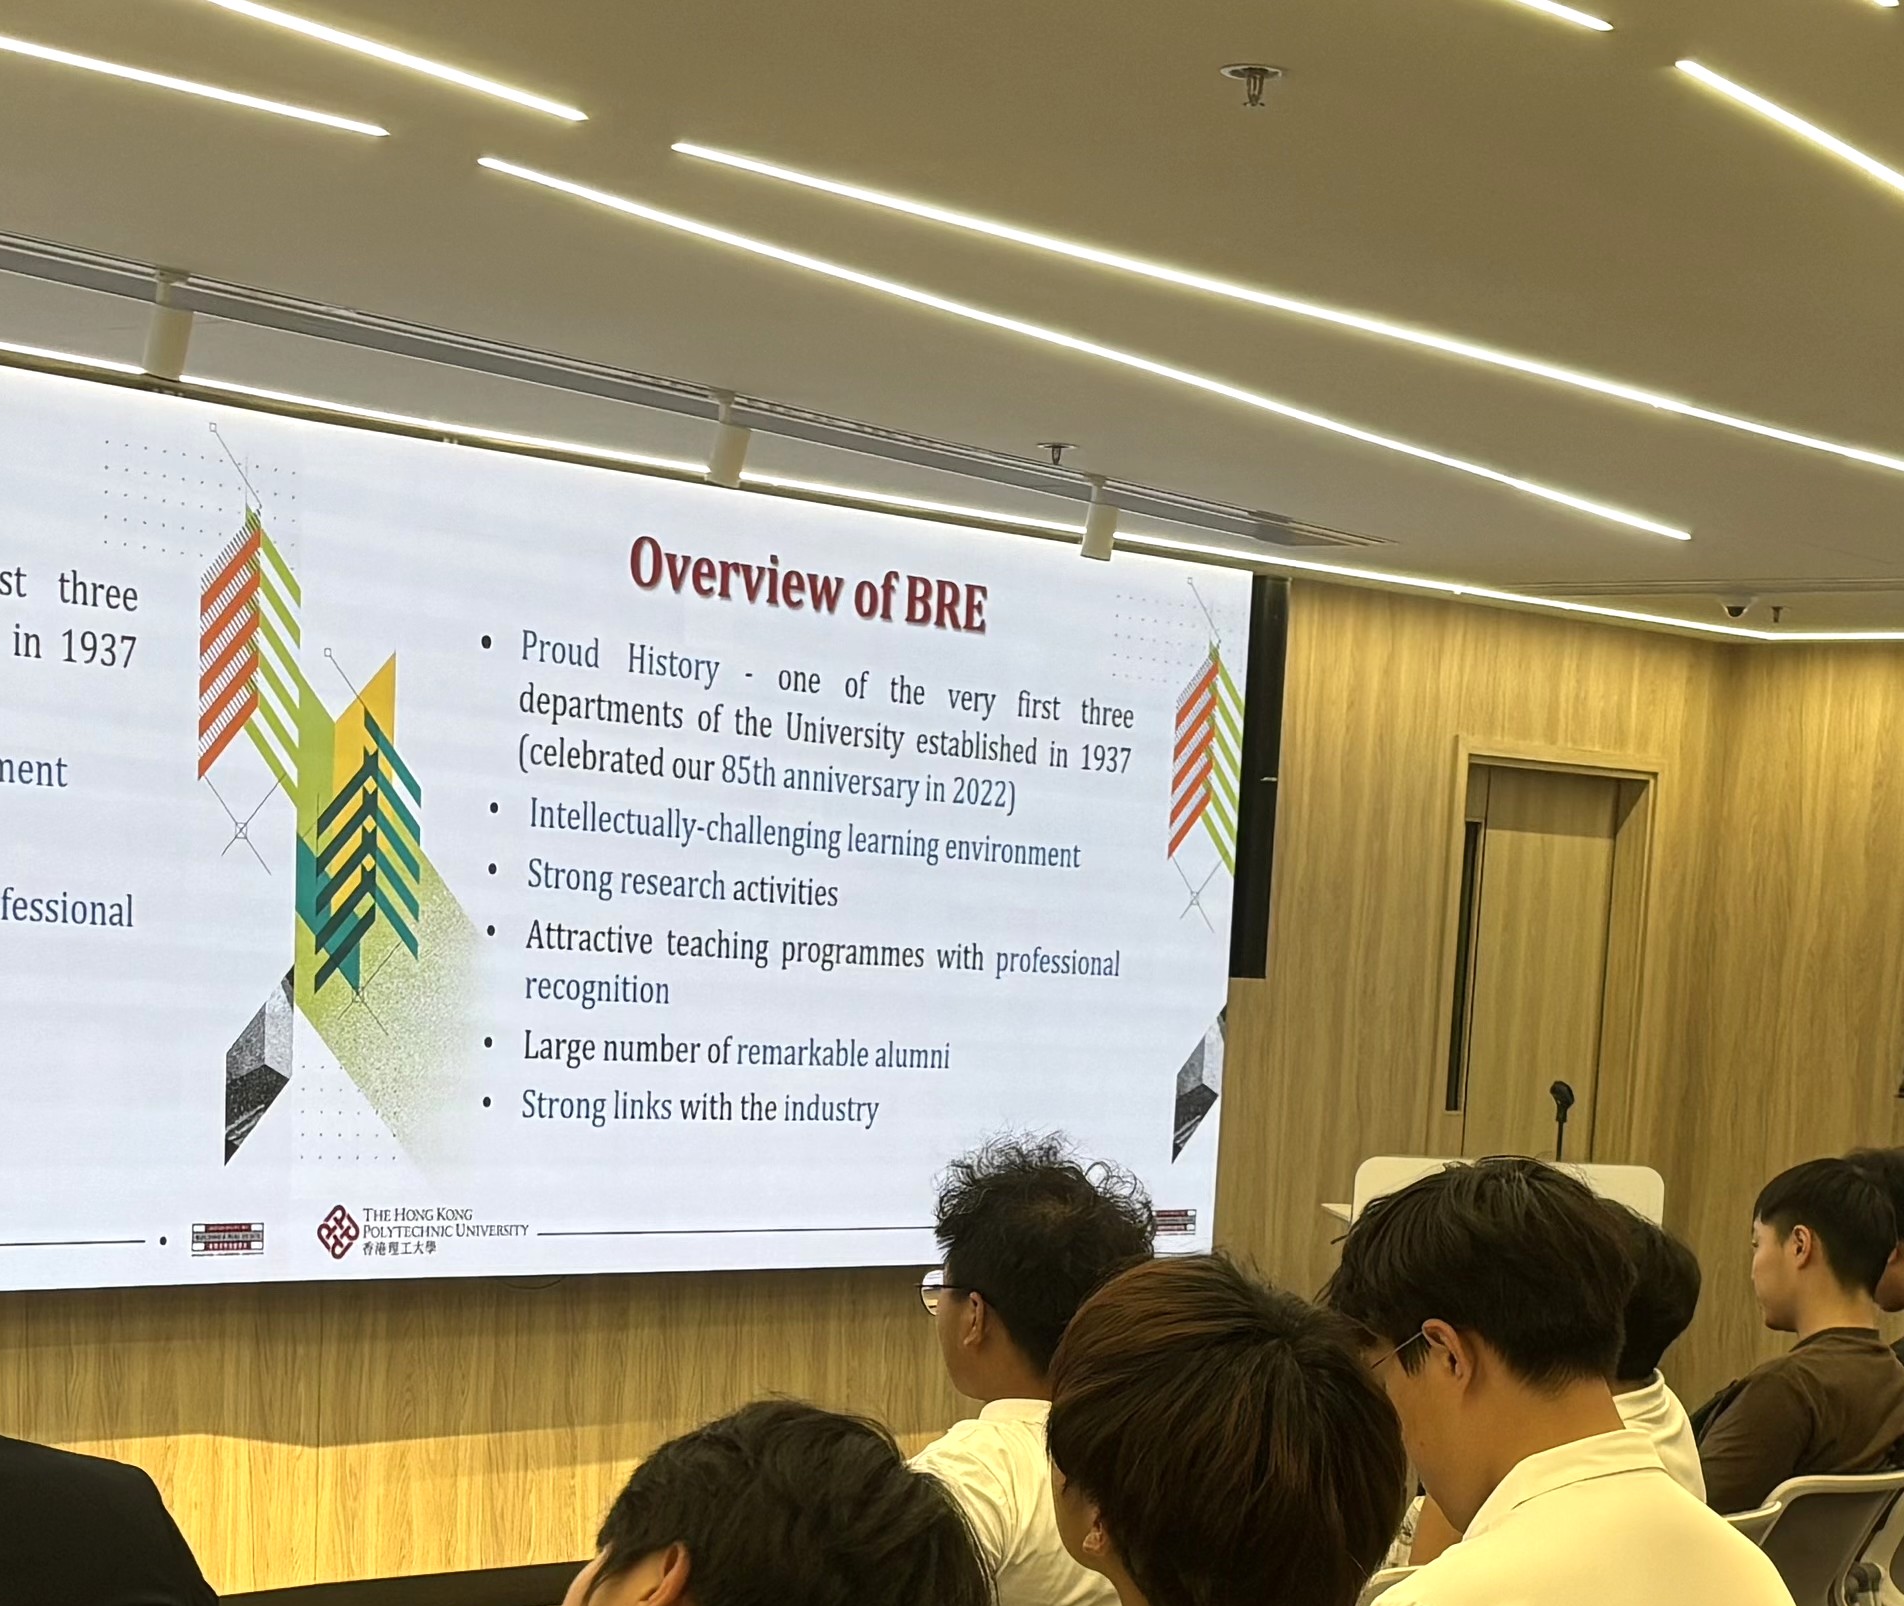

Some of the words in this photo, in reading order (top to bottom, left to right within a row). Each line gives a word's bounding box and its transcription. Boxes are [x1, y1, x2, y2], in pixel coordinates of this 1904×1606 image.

[58, 569, 138, 612] three
[630, 535, 845, 615] Overview
[854, 570, 900, 623] of
[904, 574, 988, 635] BRE
[13, 623, 42, 659] in
[62, 628, 137, 669] 1937
[522, 629, 600, 669] Proud
[628, 642, 721, 691] History
[778, 669, 821, 694] one
[844, 670, 870, 700] of
[890, 674, 925, 706] the
[947, 688, 997, 722] very
[1017, 689, 1061, 721] first
[1081, 697, 1134, 729] three
[519, 681, 684, 729] departments
[697, 703, 725, 733] of
[734, 706, 773, 738] the
[786, 711, 906, 760] University
[916, 729, 1038, 765] established
[1049, 746, 1068, 769] in
[1081, 743, 1132, 774] 1937
[519, 733, 664, 778] (celebrated
[672, 757, 716, 782] our
[721, 754, 776, 788] 85th
[783, 765, 920, 808] anniversary
[925, 774, 946, 803] in
[952, 776, 1016, 817] 2022)
[530, 796, 842, 859] Intellectually-challenging
[847, 822, 940, 866] learning
[945, 839, 1081, 869] environment
[527, 857, 614, 902] Strong
[620, 869, 726, 901] research
[733, 875, 838, 907] activities
[525, 919, 653, 955] Attractive
[667, 928, 770, 969] teaching
[781, 940, 925, 972] programmes
[936, 942, 984, 971] with
[995, 945, 1120, 980] professional
[525, 973, 669, 1010] recognition
[524, 1029, 596, 1069] Large
[603, 1032, 701, 1064] number
[707, 1035, 734, 1065] of
[736, 1037, 869, 1067] remarkable
[875, 1040, 950, 1069] alumni
[522, 1089, 607, 1128] Strong
[613, 1089, 672, 1120] links
[679, 1091, 732, 1121] with
[740, 1092, 777, 1122] the
[784, 1093, 880, 1130] industry
[362, 1207, 391, 1222] THE
[394, 1207, 434, 1222] HONG
[436, 1207, 473, 1222] KONG
[363, 1224, 453, 1239] POLYTECHNIC
[455, 1223, 530, 1238] UNIVERSITY
